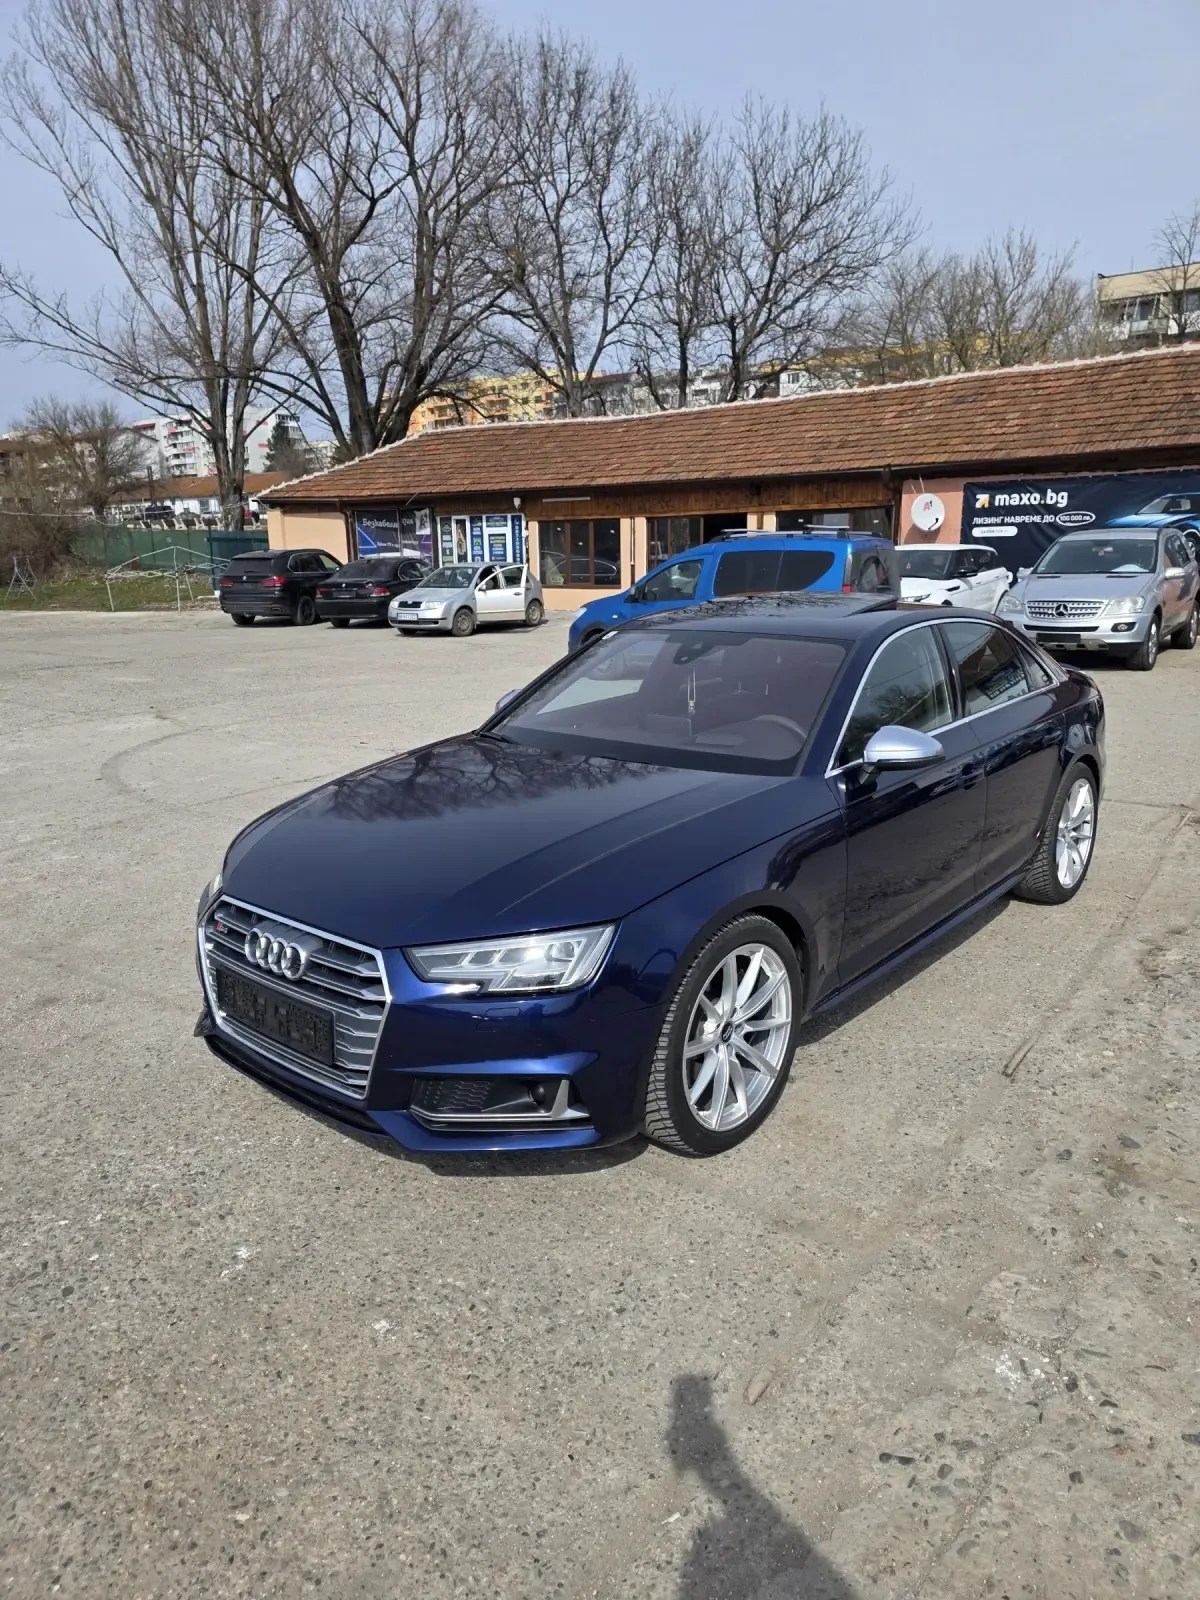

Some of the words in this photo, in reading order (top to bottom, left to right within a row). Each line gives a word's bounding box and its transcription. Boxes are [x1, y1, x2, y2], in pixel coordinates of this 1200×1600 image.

[994, 488, 1069, 508] maxo.bg
[972, 516, 1004, 525] ЛИЗИНГ
[1004, 515, 1042, 524] НАВРЕМЕ
[1042, 514, 1055, 523] ДО
